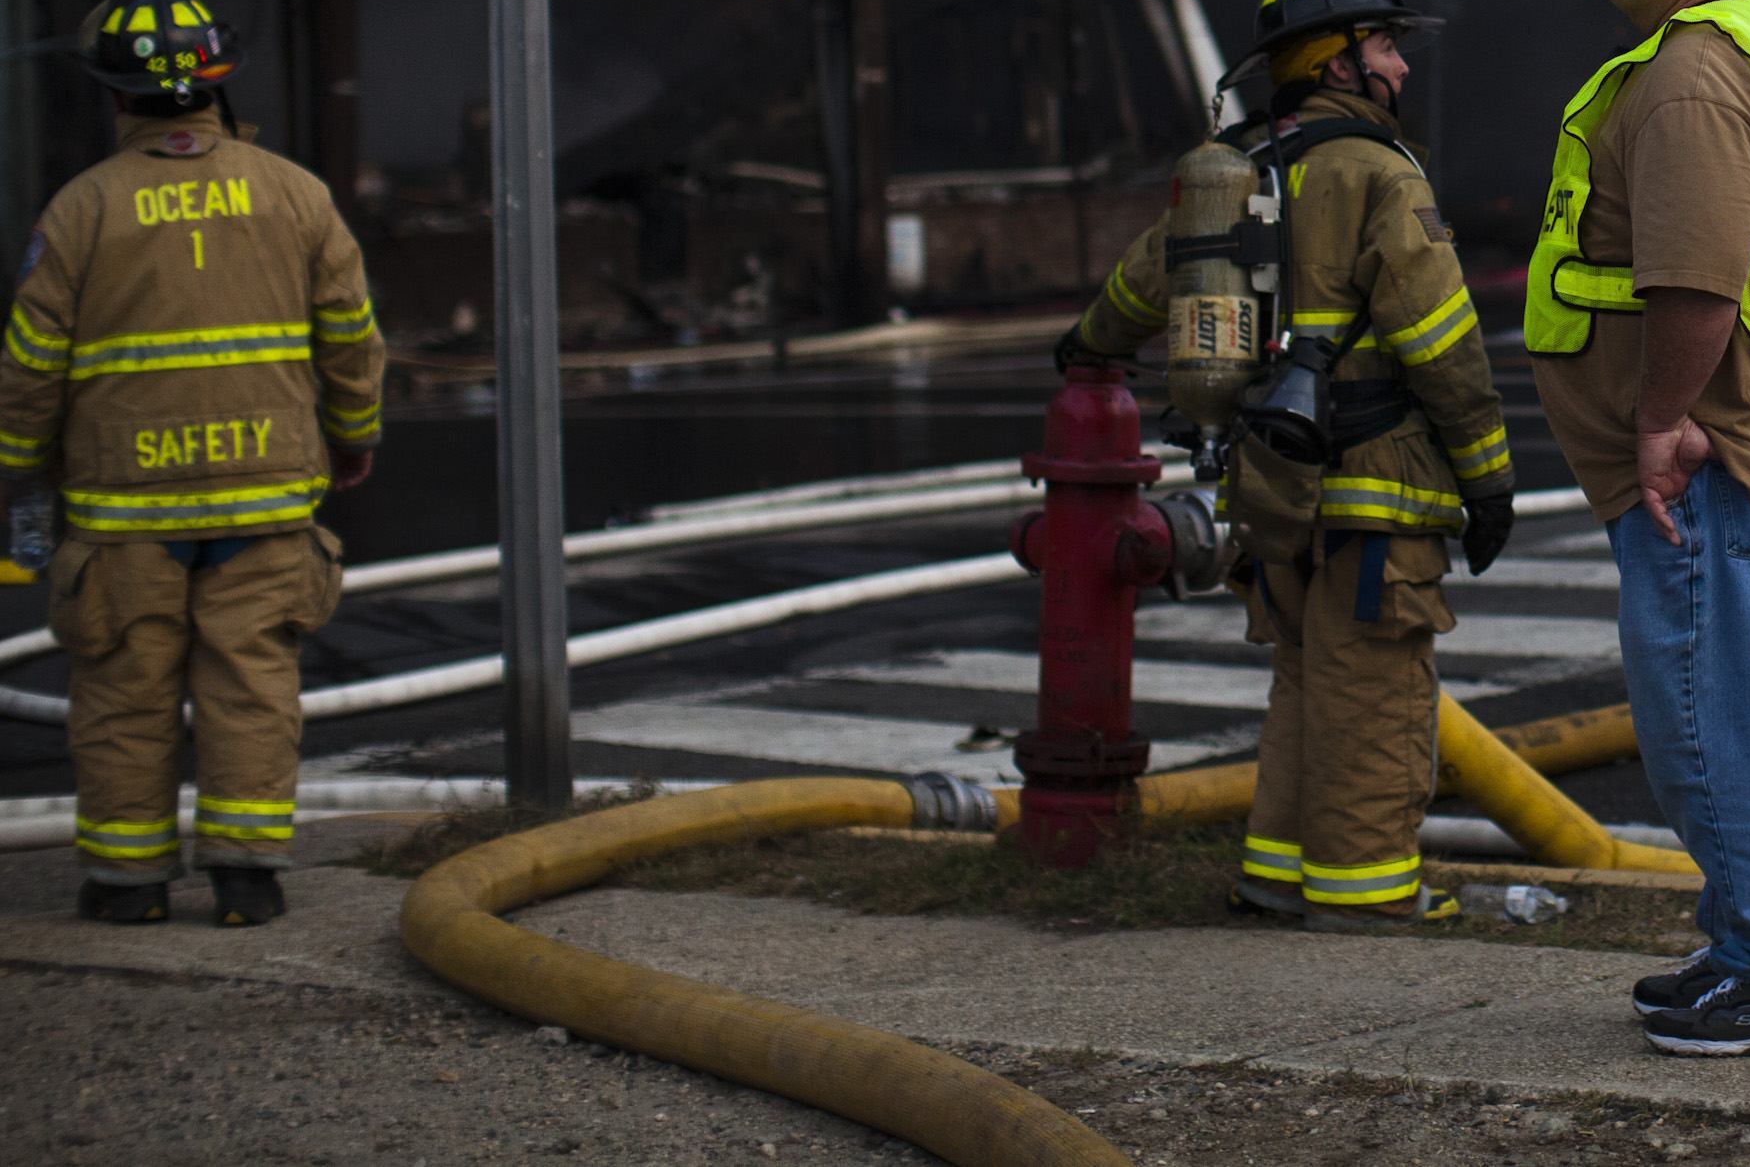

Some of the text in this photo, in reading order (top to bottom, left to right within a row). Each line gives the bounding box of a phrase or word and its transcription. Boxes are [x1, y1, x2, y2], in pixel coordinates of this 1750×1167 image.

[145, 50, 198, 74] 42 50
[135, 177, 252, 227] OCEAN
[189, 230, 205, 271] 1
[1238, 300, 1252, 355] SCOTT
[136, 418, 272, 469] SAFETY
